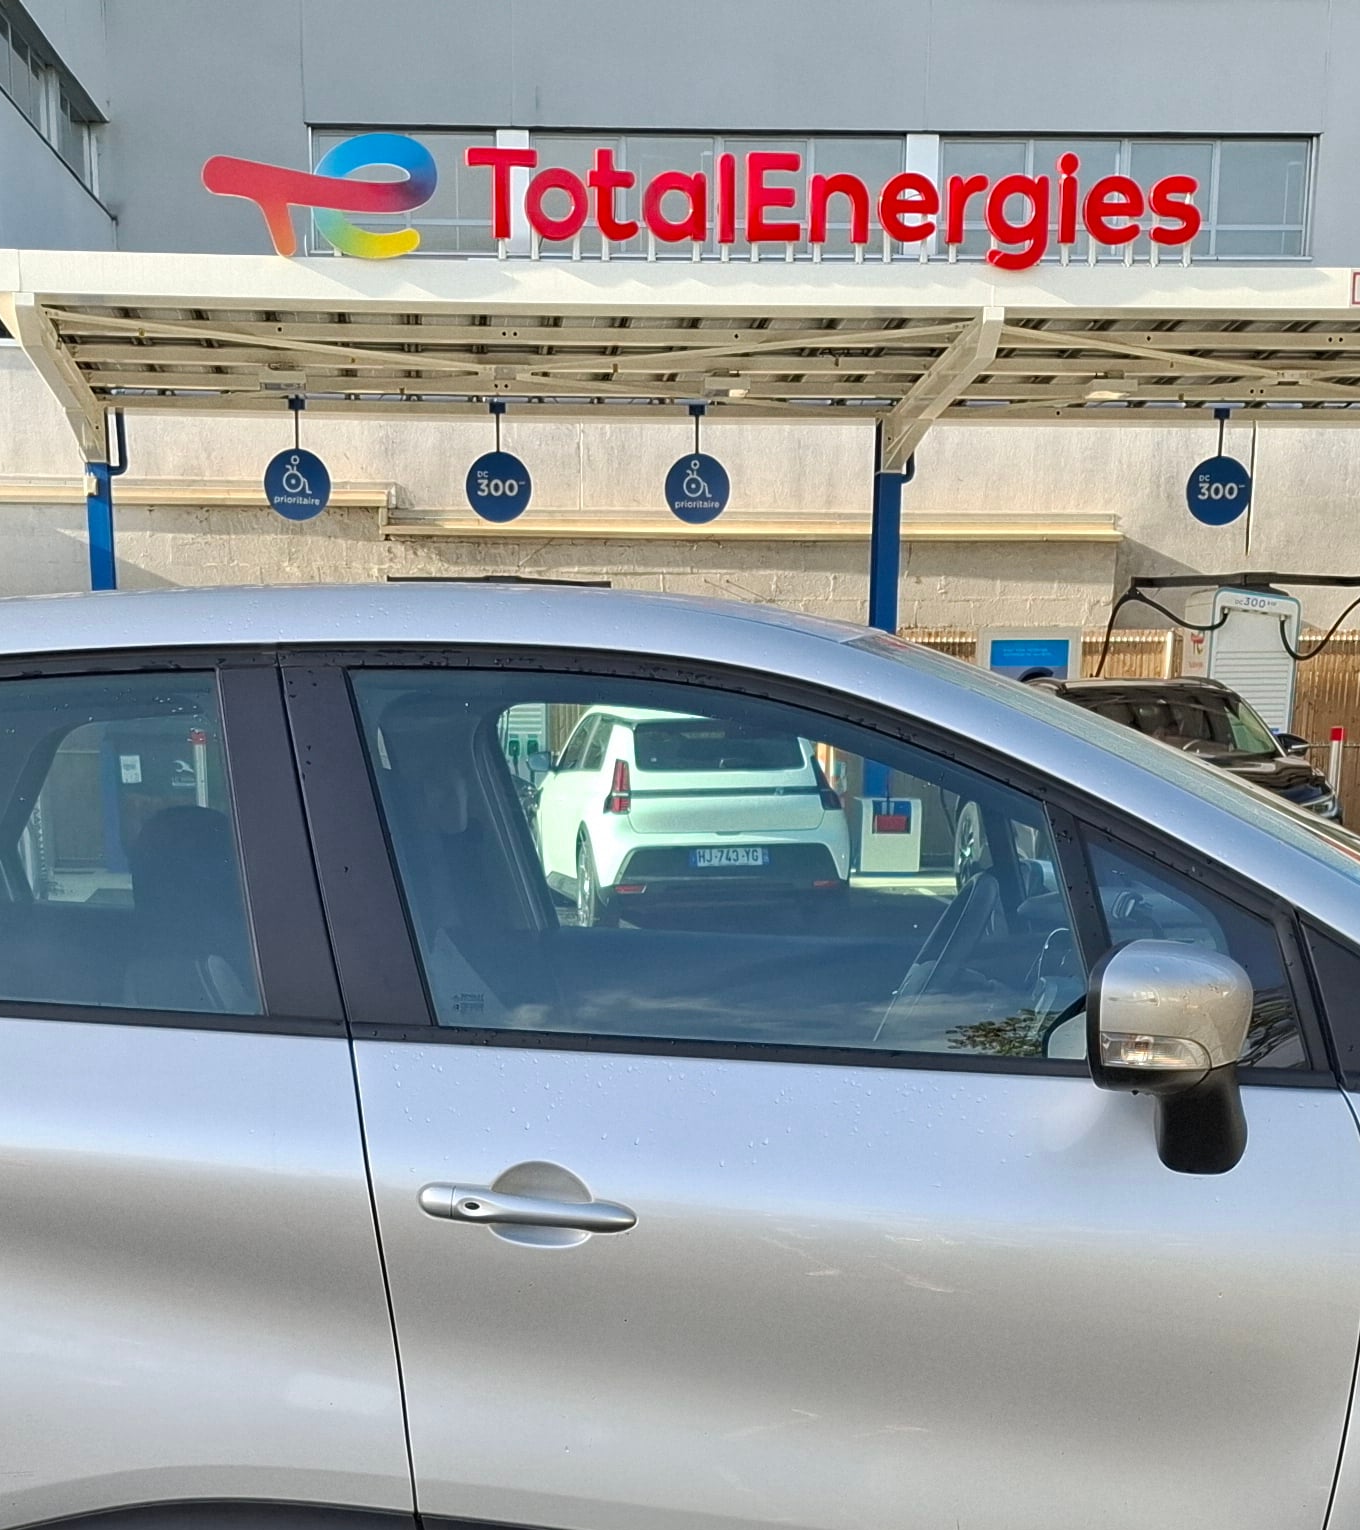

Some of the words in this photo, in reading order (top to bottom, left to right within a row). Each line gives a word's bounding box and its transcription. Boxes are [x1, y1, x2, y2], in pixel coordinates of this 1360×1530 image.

[465, 147, 1202, 271] TotalEnergies
[1199, 474, 1210, 482] DC
[477, 479, 519, 497] 300
[1198, 482, 1238, 500] 300
[273, 495, 320, 506] prioritaire
[674, 500, 720, 509] prioritaire
[1243, 597, 1266, 609] 300
[698, 849, 758, 863] HJ-743-YG
